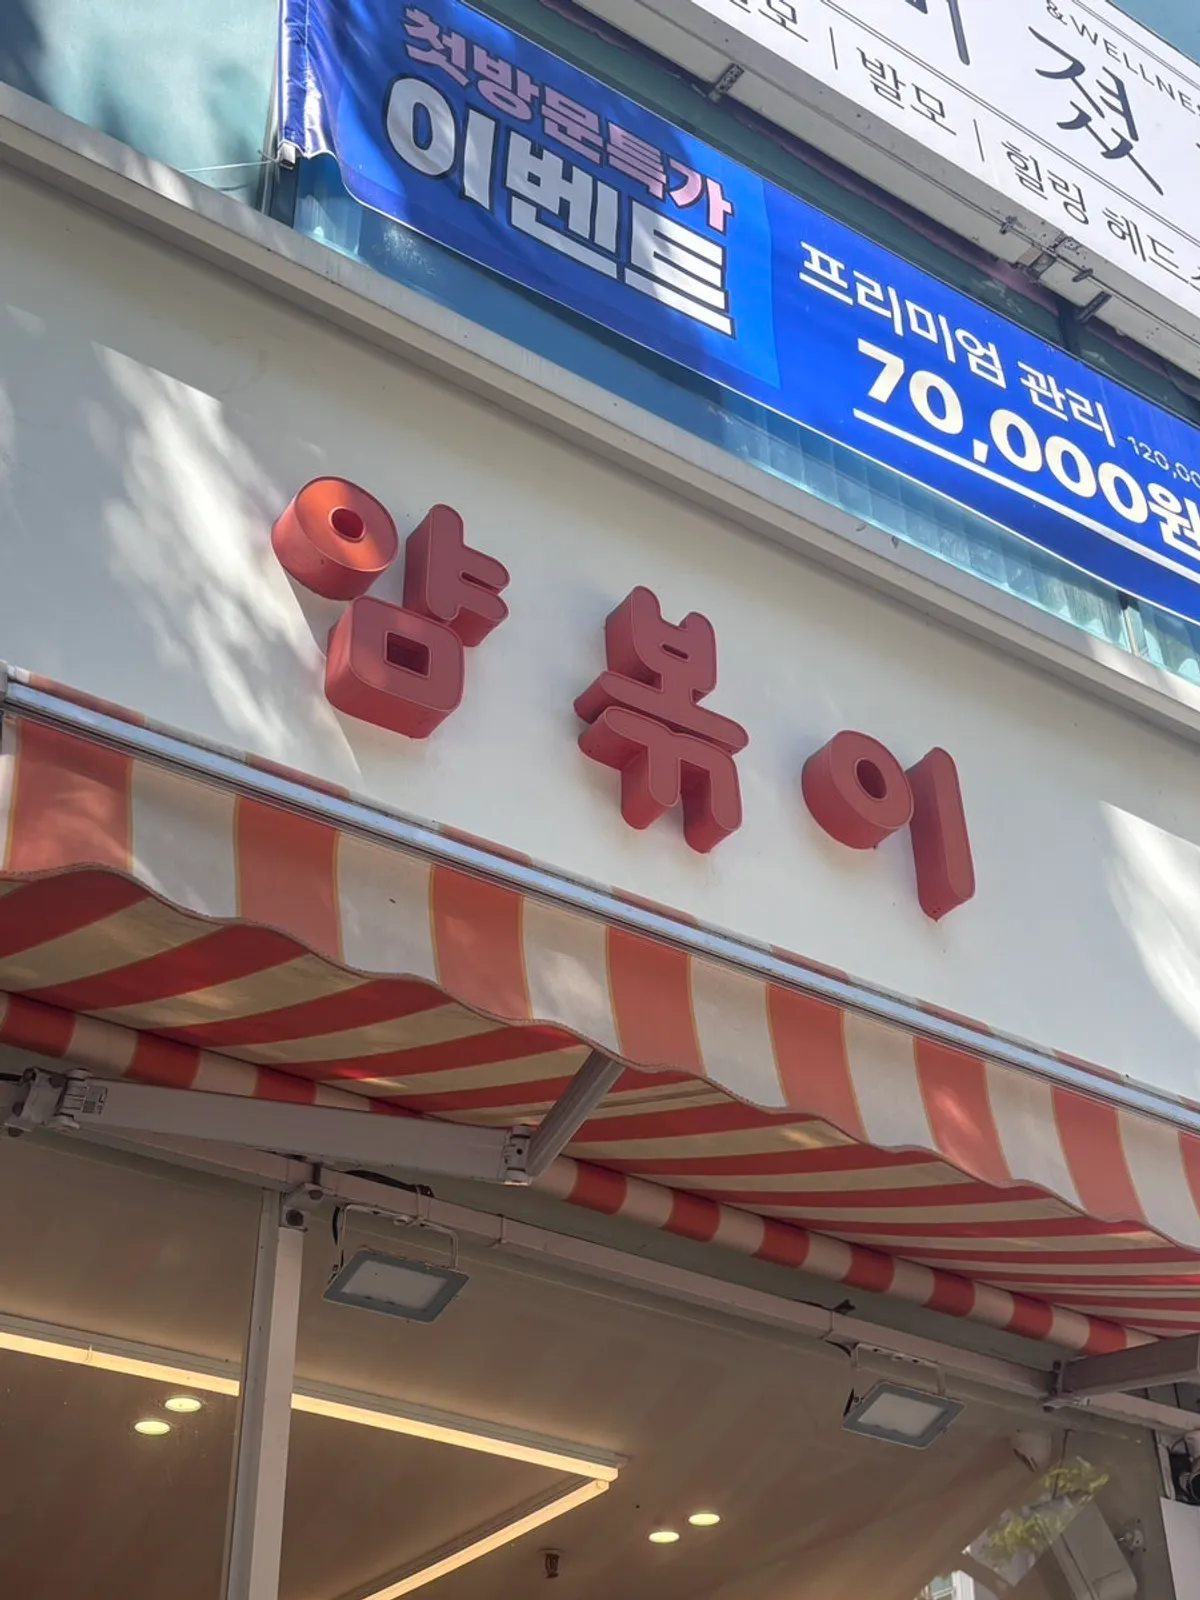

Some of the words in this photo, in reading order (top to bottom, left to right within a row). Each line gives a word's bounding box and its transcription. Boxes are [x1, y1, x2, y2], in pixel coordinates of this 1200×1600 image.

[385, 76, 736, 338] 이벤트
[729, 0, 809, 43] 모
[856, 46, 957, 136] 발모
[1001, 141, 1090, 225] 힐링
[1102, 207, 1200, 293] 헤드
[799, 241, 1007, 389] 프리미엄
[1018, 361, 1116, 448] 관리
[857, 338, 1200, 561] 70,000원
[271, 475, 976, 923] 얌볶이
